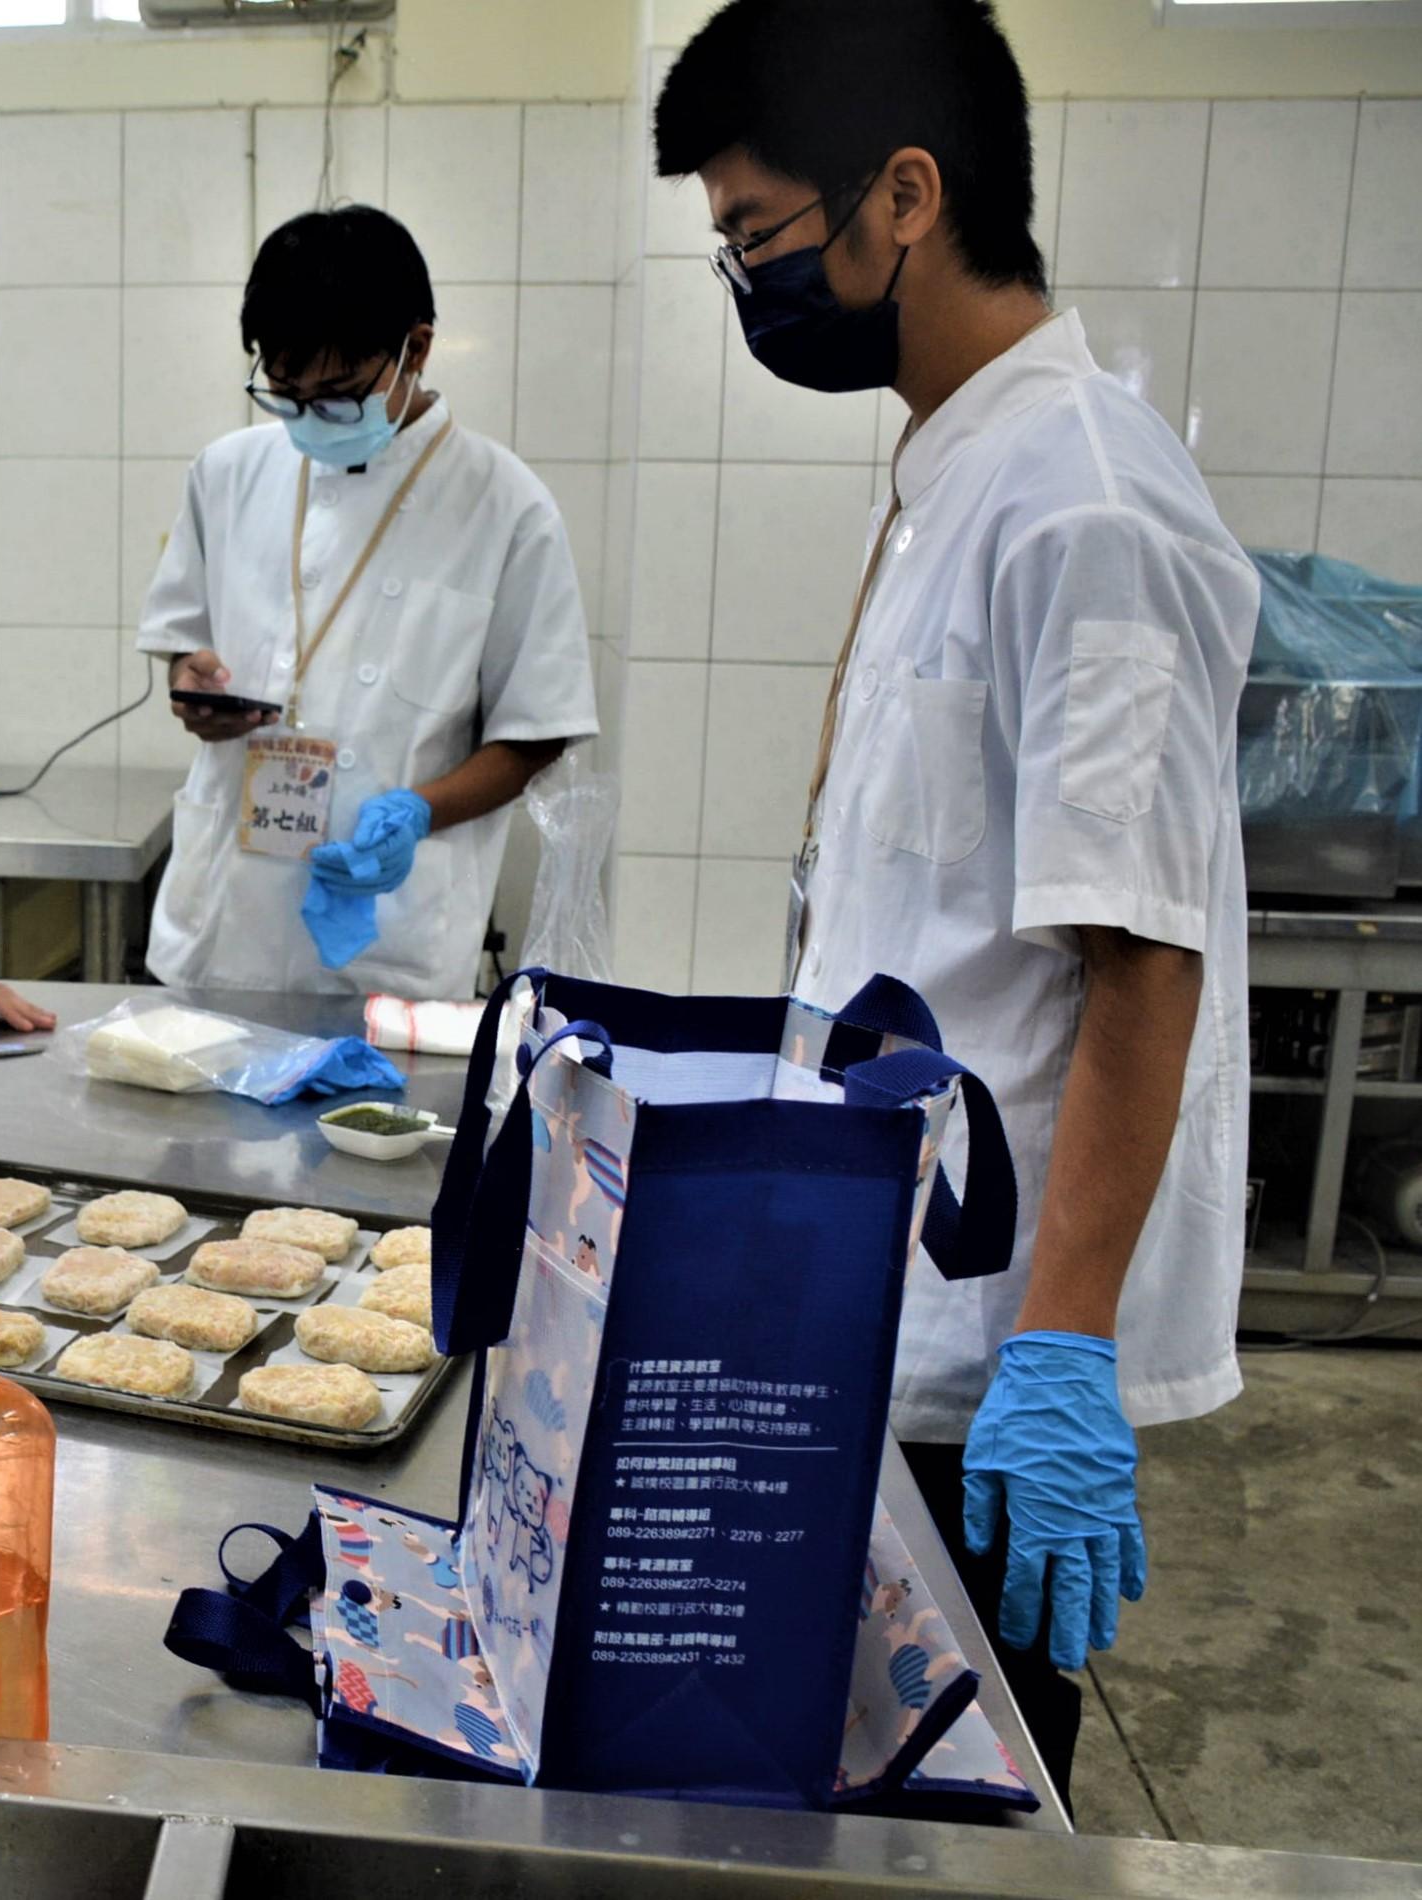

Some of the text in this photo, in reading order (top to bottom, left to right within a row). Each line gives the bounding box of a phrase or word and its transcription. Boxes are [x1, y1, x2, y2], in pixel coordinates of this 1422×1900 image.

[252, 805, 318, 832] 第七組
[629, 1359, 722, 1374] 什麼是資源教室
